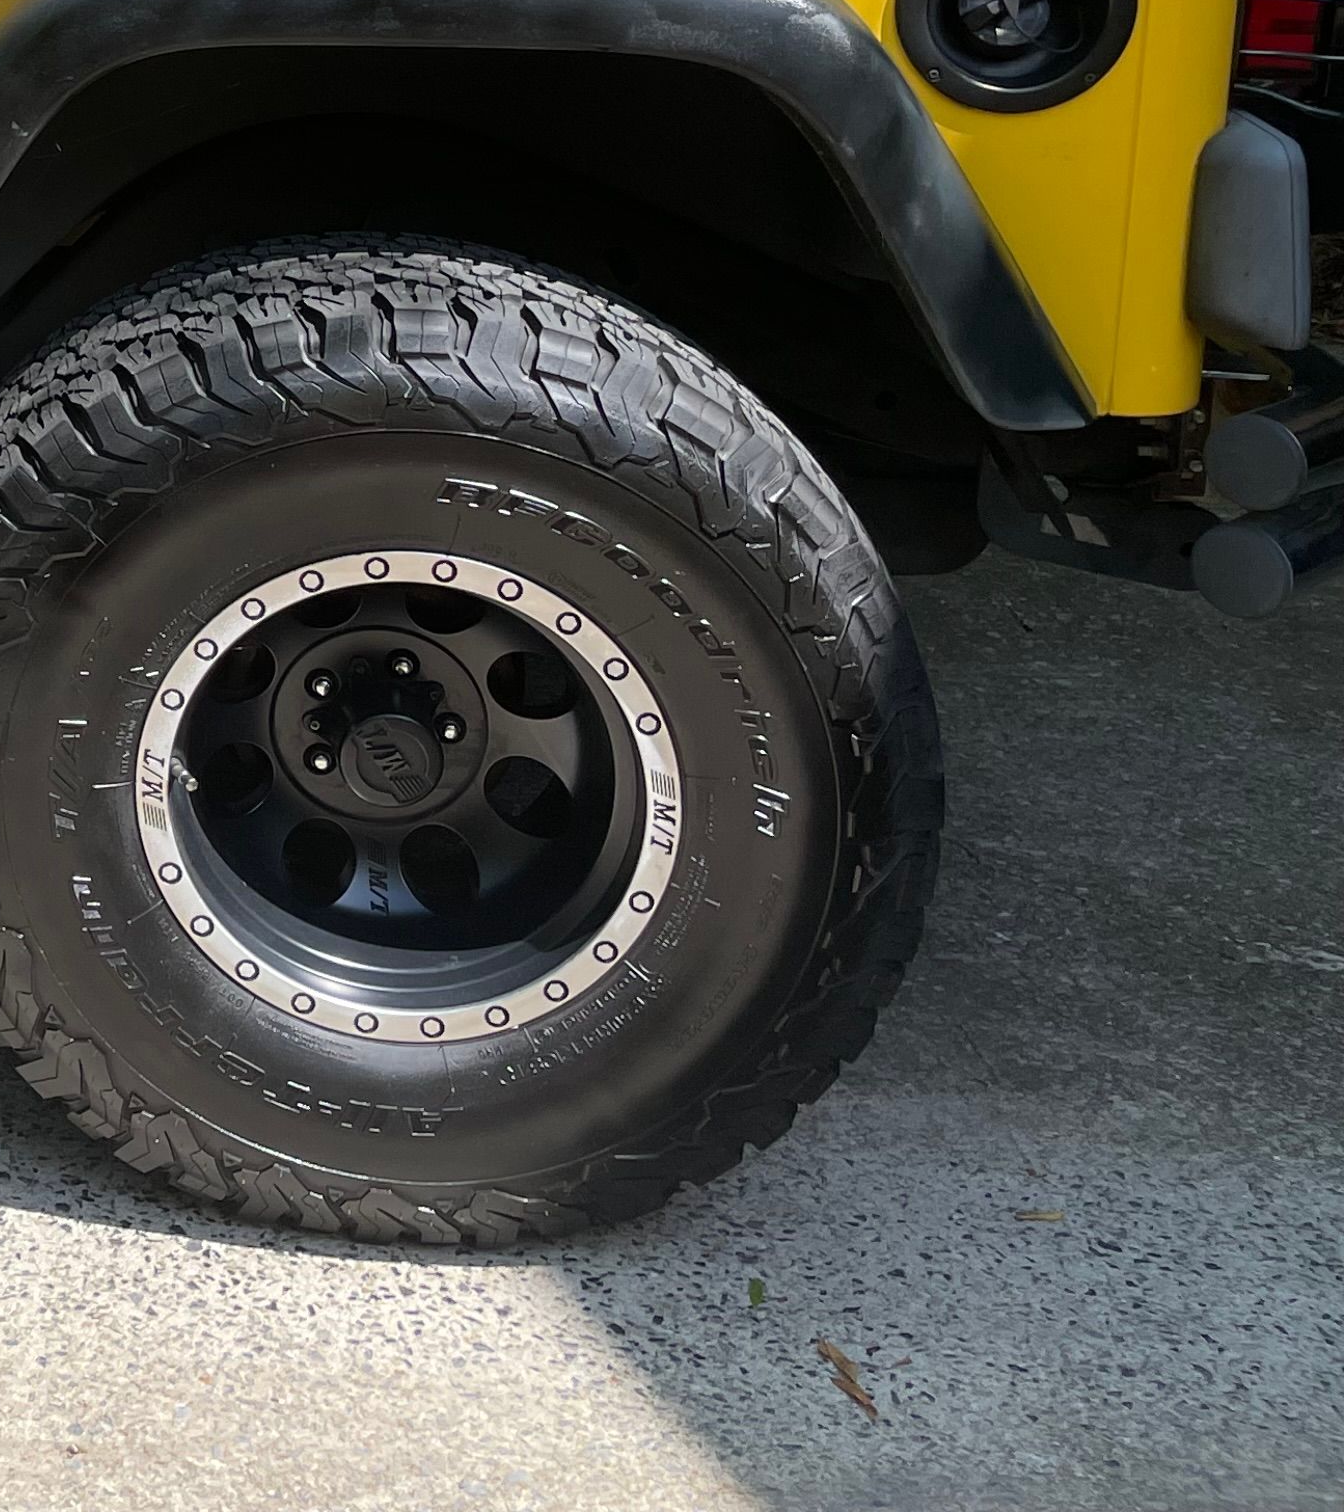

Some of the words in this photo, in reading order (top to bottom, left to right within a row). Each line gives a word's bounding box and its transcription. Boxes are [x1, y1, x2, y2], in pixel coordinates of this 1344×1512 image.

[435, 476, 792, 838] BFGoodrich
[141, 748, 166, 803] M/T
[649, 800, 676, 856] M/T
[368, 865, 391, 917] M/T
